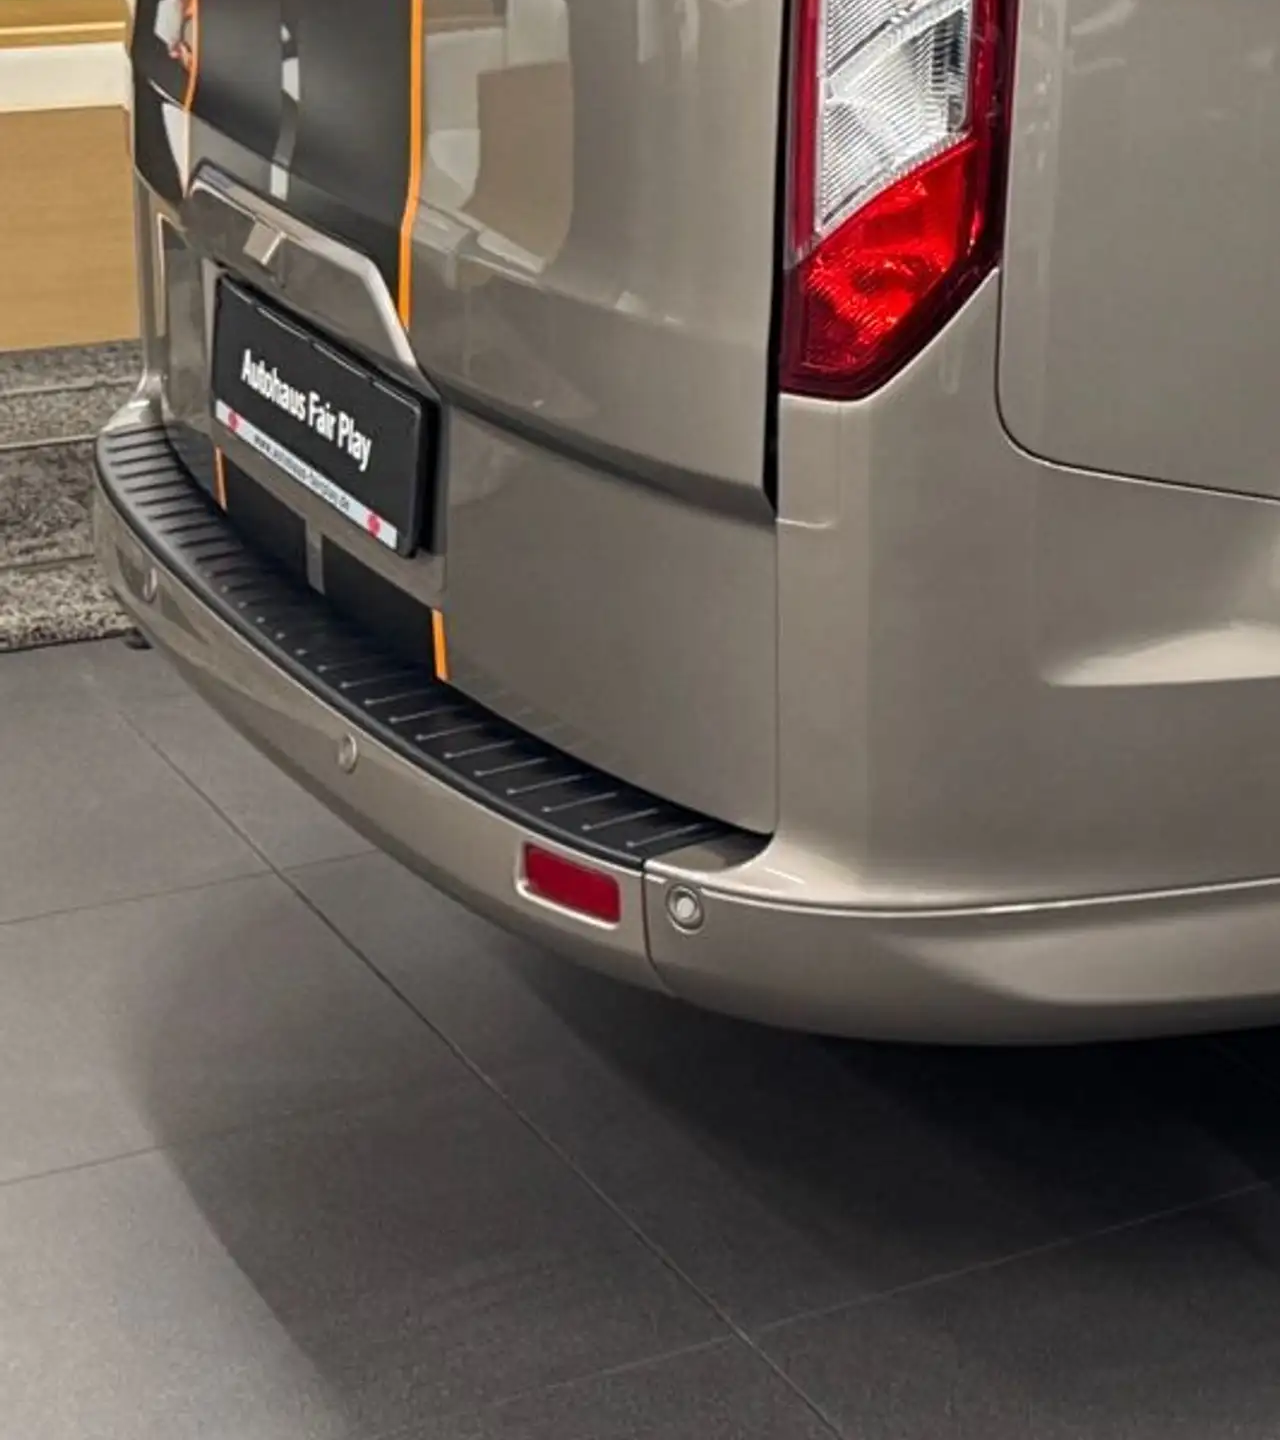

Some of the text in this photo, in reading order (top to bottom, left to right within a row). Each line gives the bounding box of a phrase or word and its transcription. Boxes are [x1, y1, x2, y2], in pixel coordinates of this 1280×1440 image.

[240, 348, 373, 472] Autohaus Fair Play
